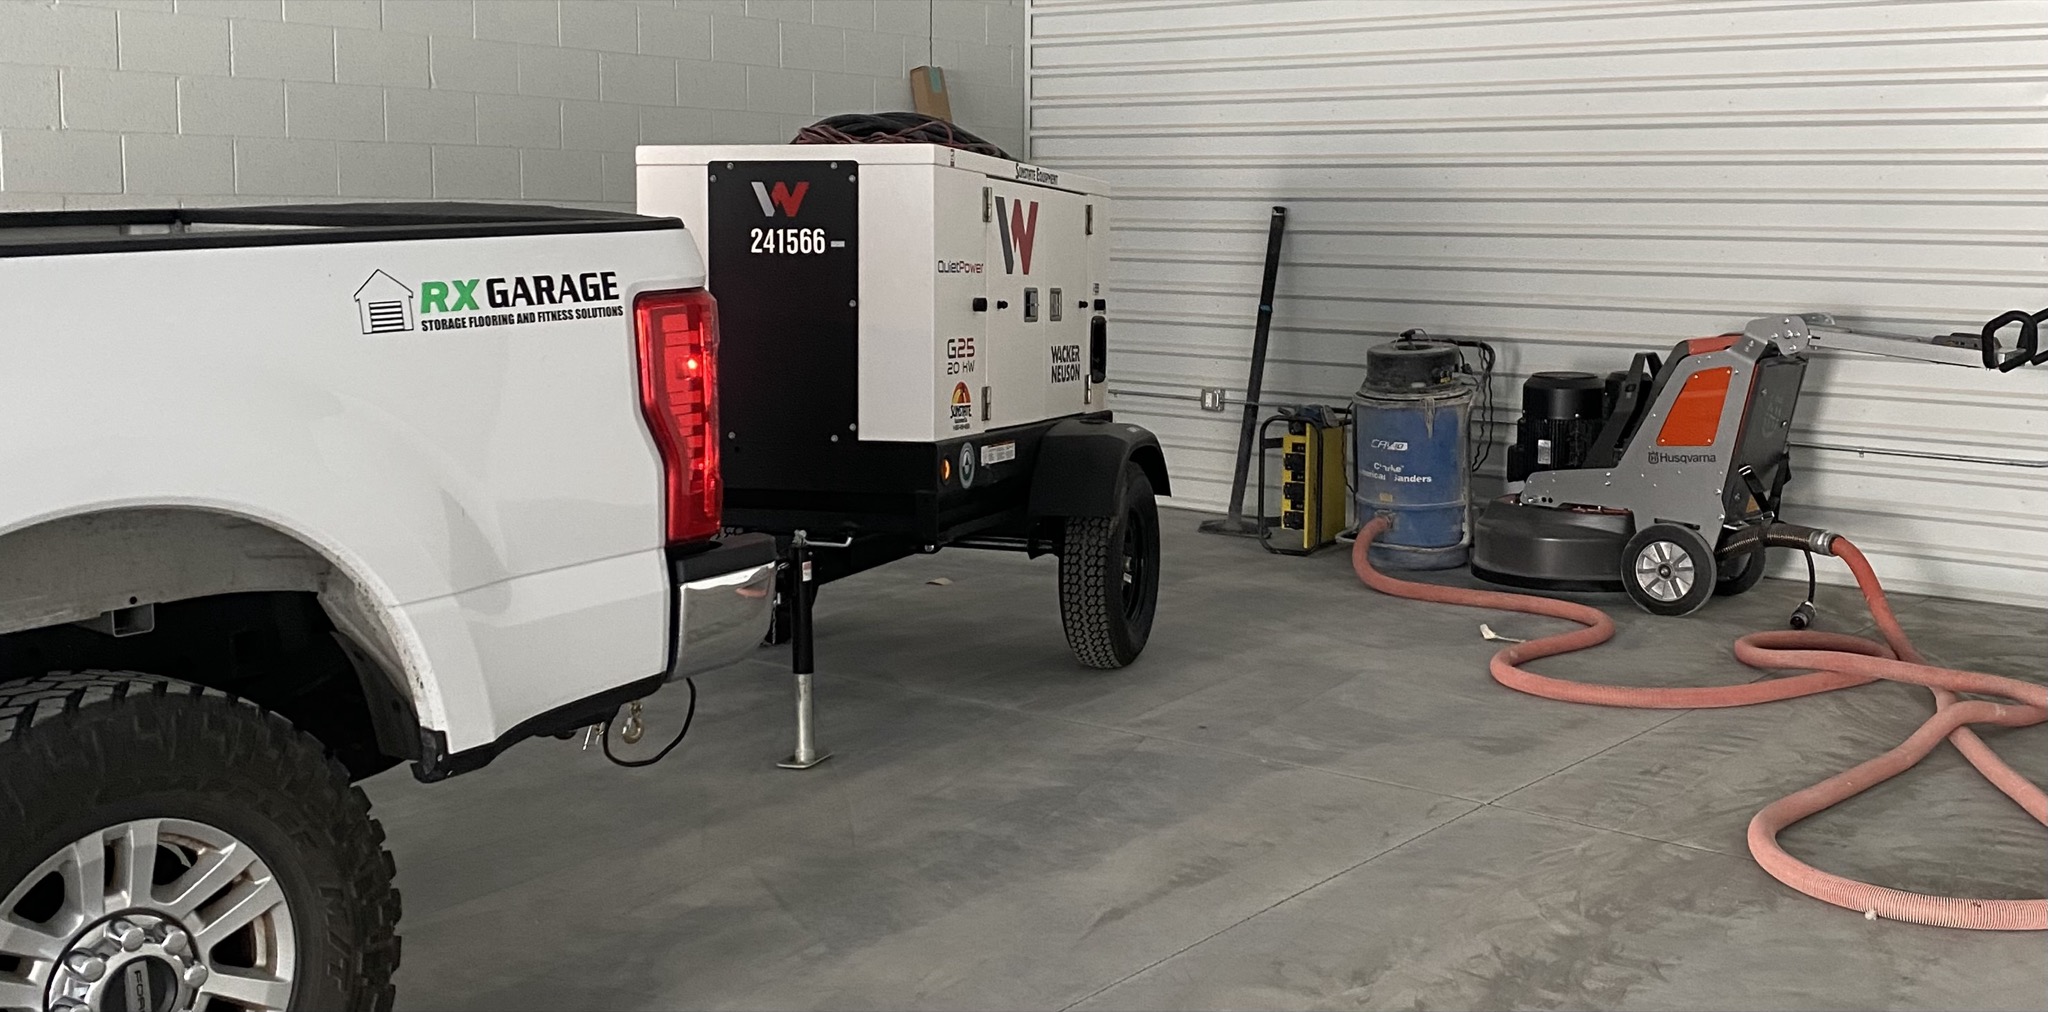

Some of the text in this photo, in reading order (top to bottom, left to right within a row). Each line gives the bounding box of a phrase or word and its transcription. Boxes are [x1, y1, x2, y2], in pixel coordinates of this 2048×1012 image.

[750, 227, 826, 254] 241566
[937, 260, 984, 274] QuietPower
[420, 271, 620, 314] RX GARAGE
[421, 305, 624, 332] STORAGE FLOORING AND FITNESS SOLUTIONS
[947, 337, 975, 359] G25
[1051, 345, 1080, 363] WACKER
[947, 361, 960, 375] 20
[1051, 364, 1080, 383] NEUSON
[1659, 452, 1716, 464] Husqvarna
[134, 969, 147, 1012] FOR
